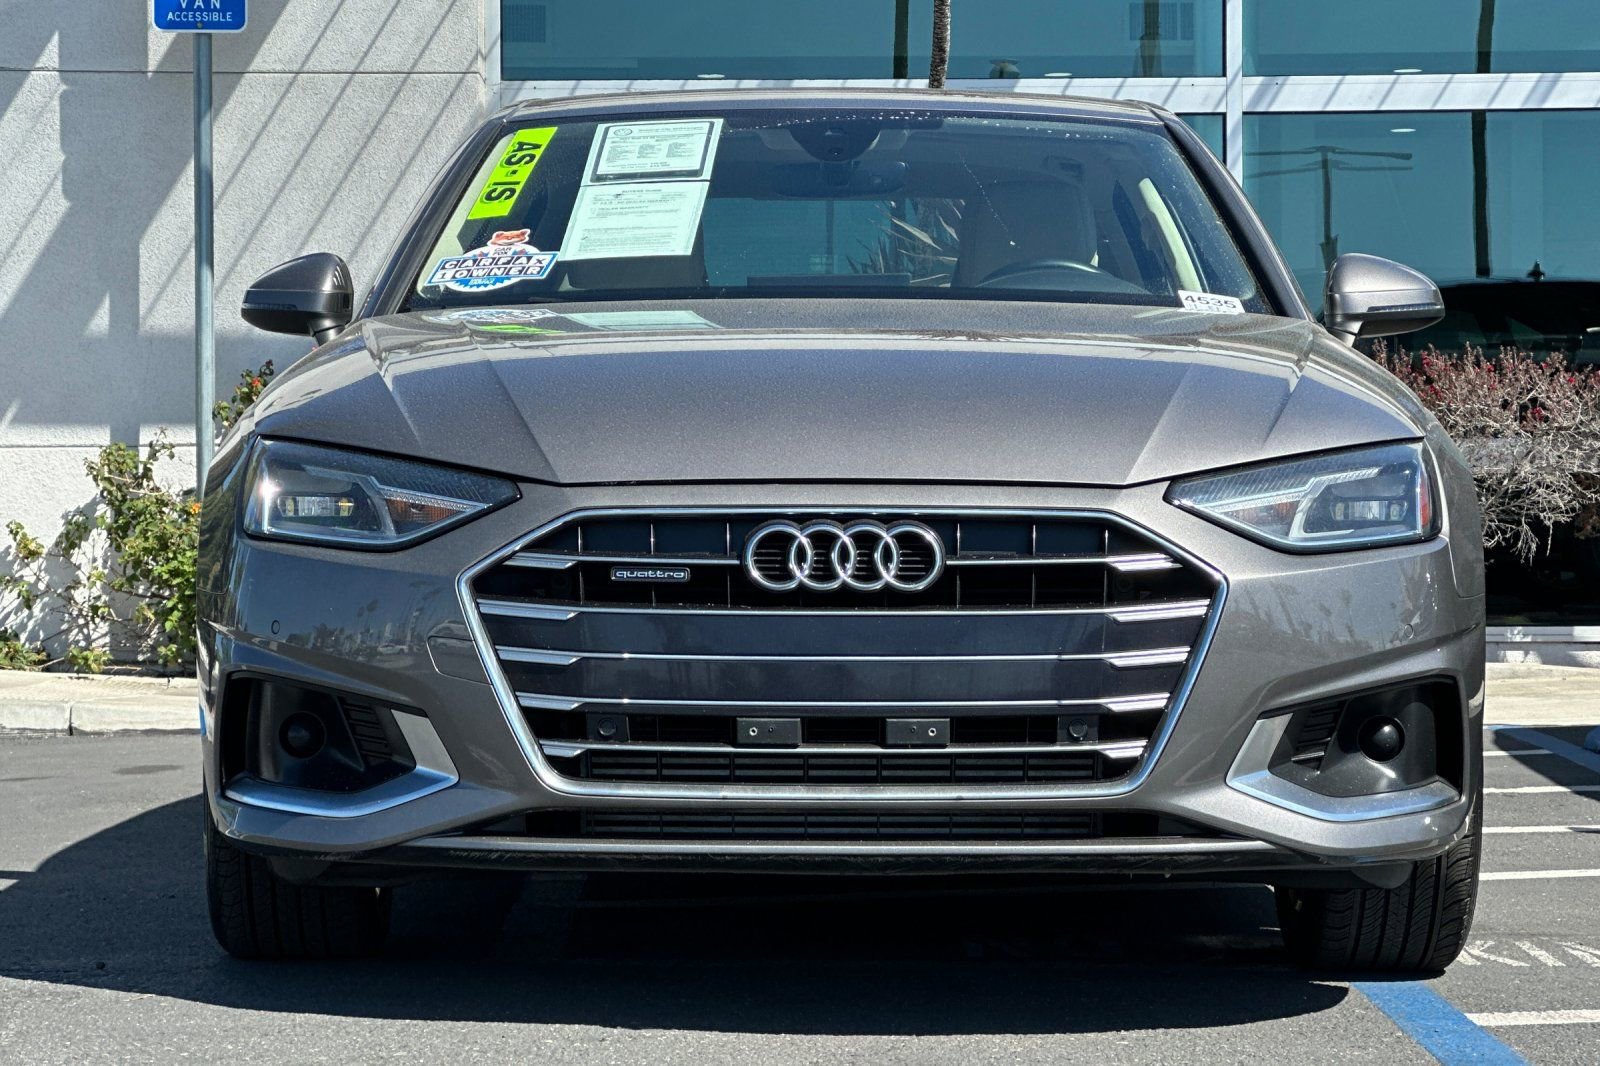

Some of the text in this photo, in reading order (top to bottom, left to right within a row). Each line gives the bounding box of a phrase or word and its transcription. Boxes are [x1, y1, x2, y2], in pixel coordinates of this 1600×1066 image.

[180, 0, 221, 9] VAN
[166, 11, 233, 22] ACCESSIBLE
[444, 255, 545, 269] CARFAX
[1184, 295, 1237, 309] 4535
[615, 570, 685, 579] quattro
